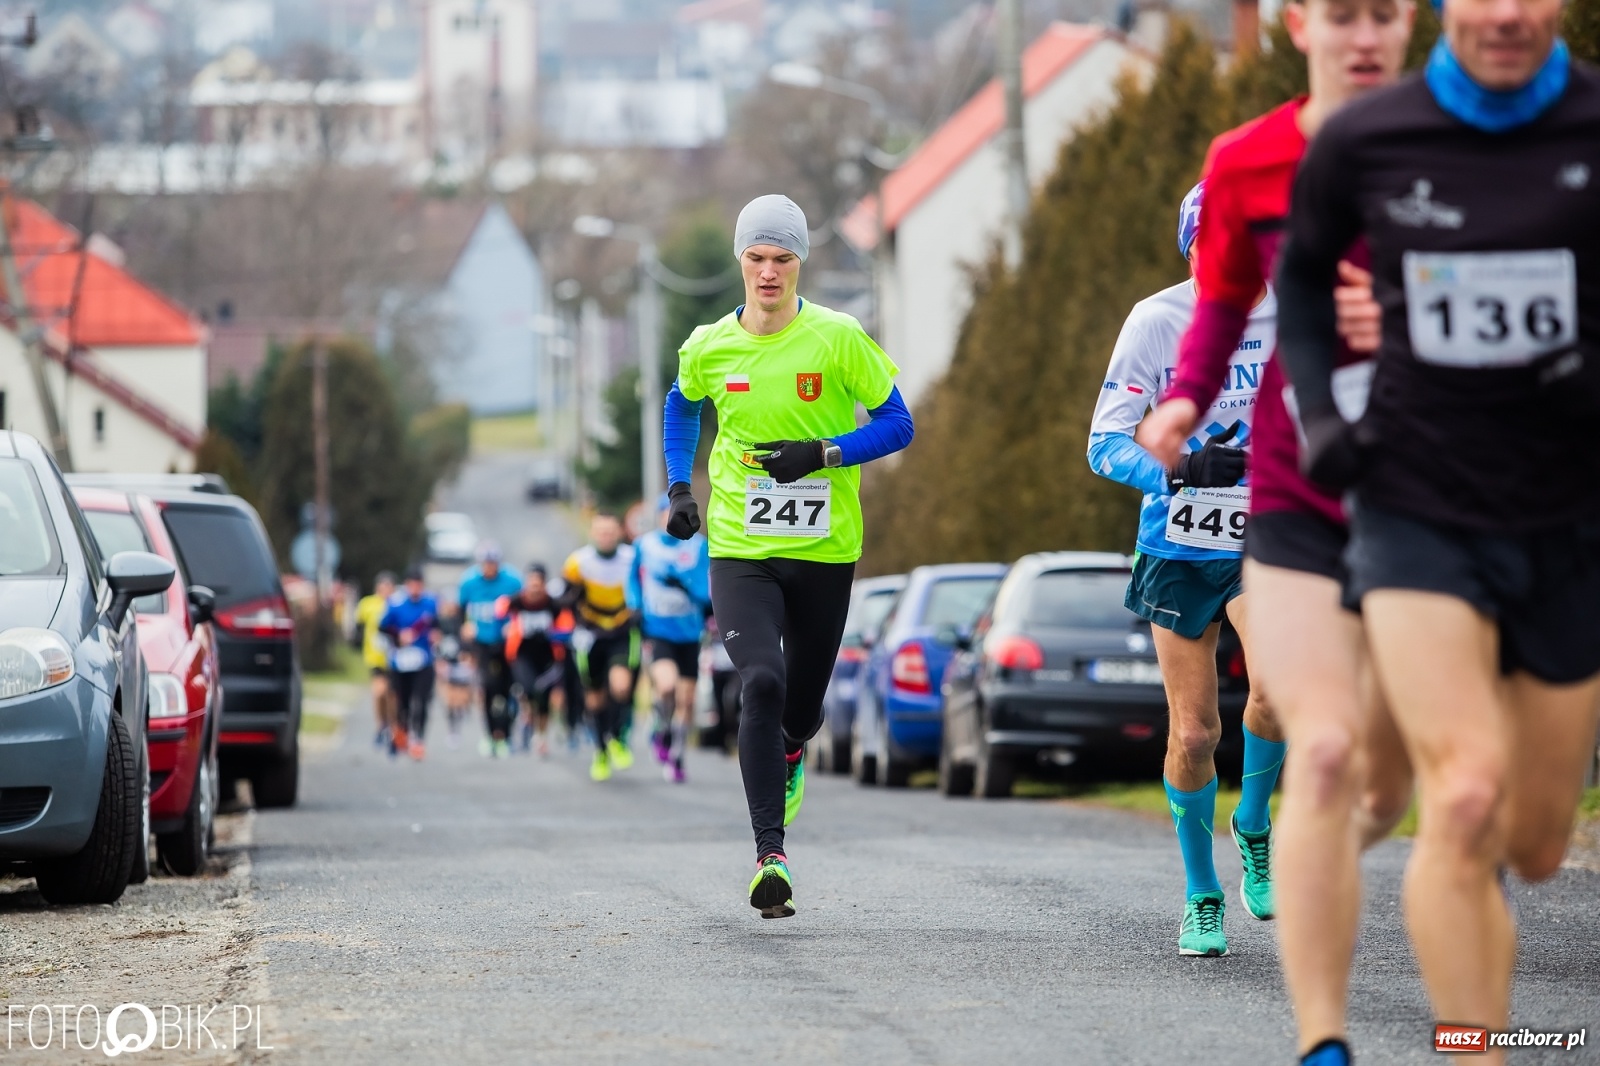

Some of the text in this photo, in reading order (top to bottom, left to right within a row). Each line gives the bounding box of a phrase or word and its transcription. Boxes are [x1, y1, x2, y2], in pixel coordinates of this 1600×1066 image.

[1425, 295, 1563, 343] 136
[1206, 397, 1257, 410] -OKNA
[1201, 491, 1252, 501] www.personalbest
[749, 497, 826, 526] 247
[1171, 504, 1250, 540] 449
